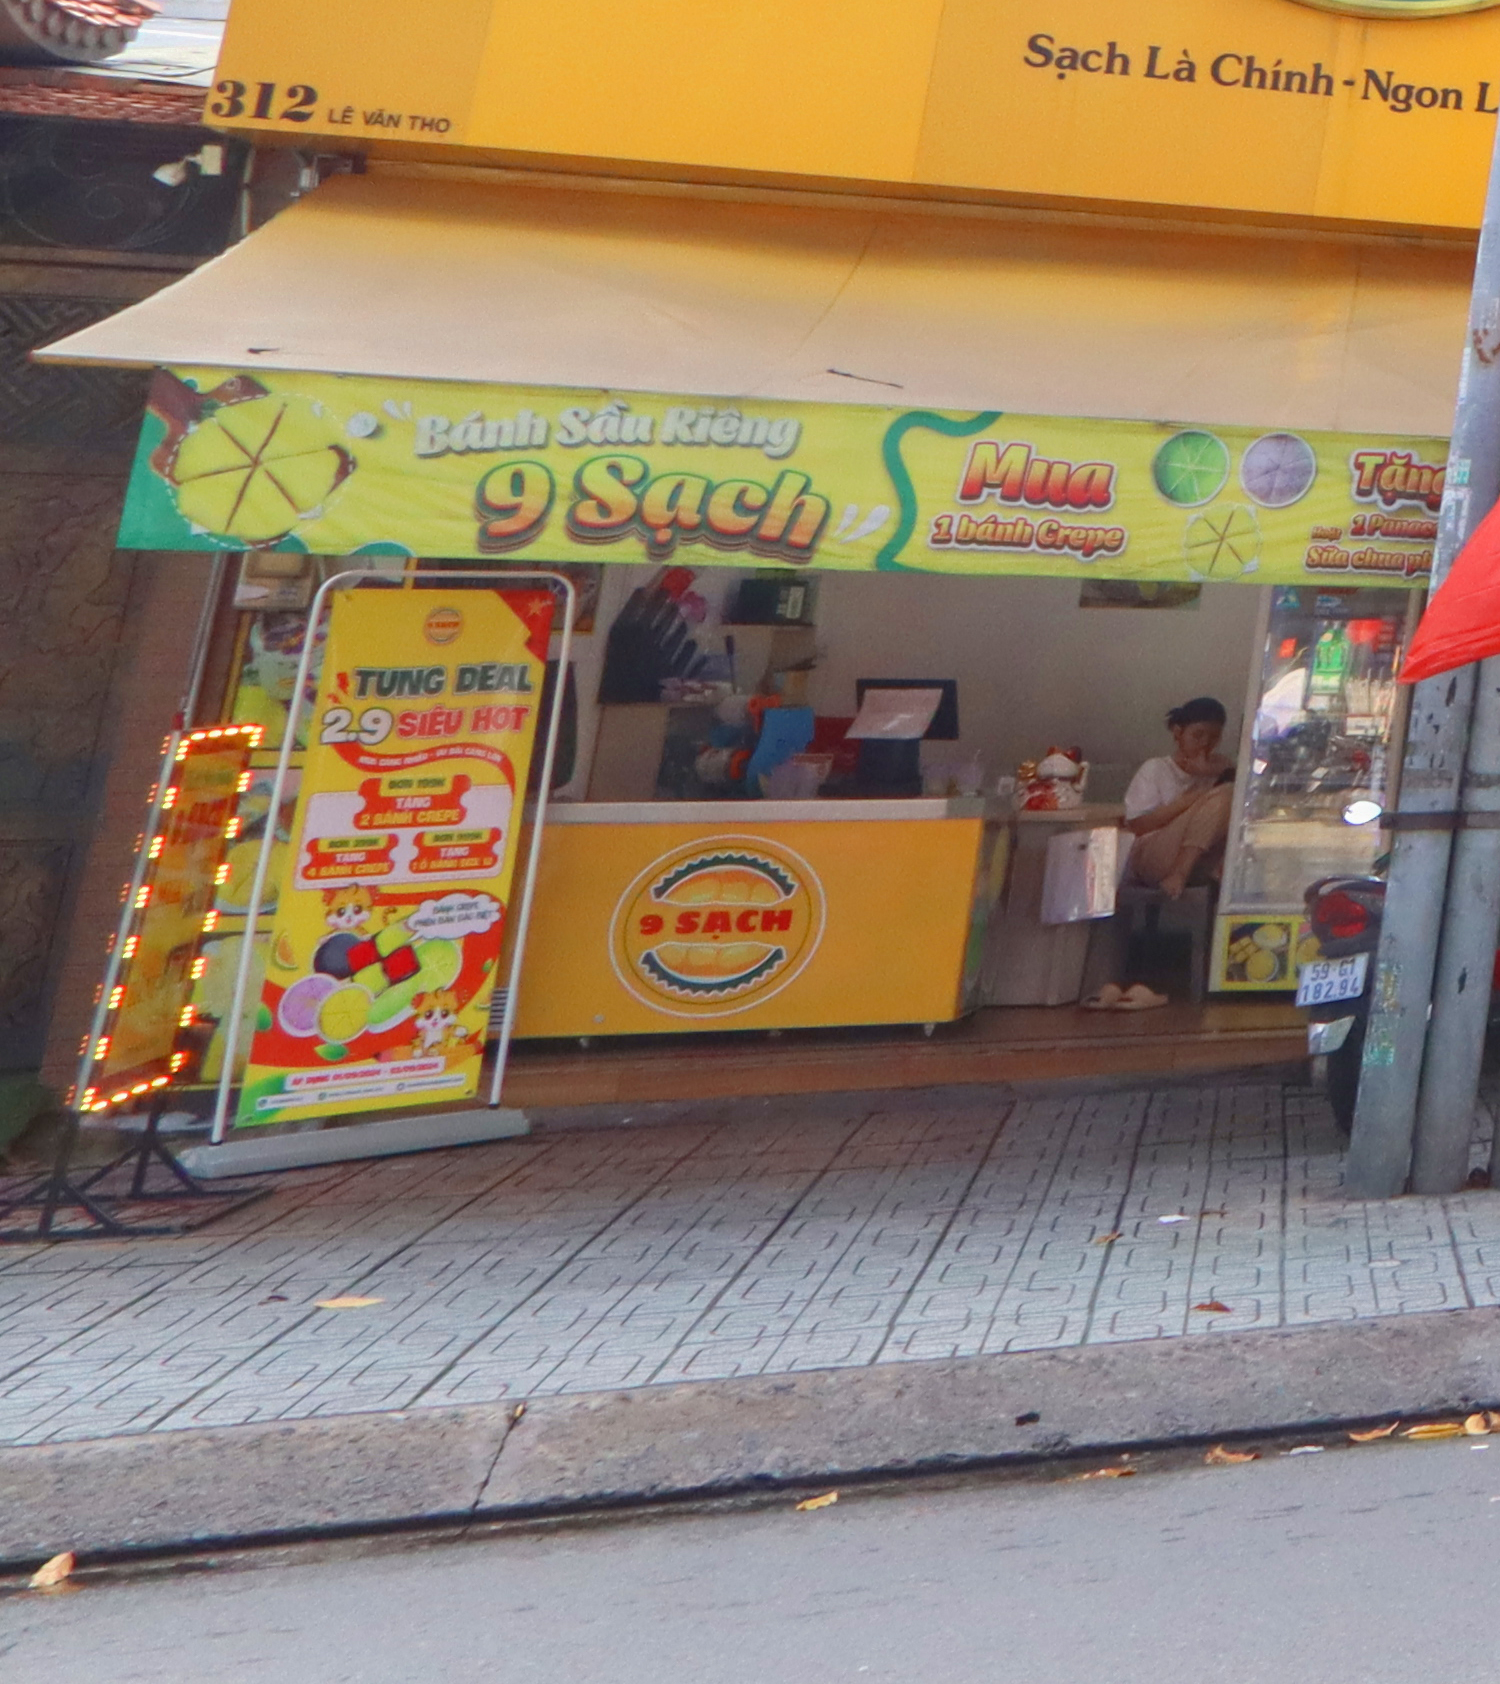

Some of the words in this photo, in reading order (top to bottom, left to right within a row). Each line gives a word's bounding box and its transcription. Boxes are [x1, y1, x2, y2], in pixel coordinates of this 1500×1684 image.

[1024, 33, 1131, 81] Sạch
[1144, 46, 1197, 86] Là
[1210, 52, 1335, 98] Chính
[1363, 68, 1463, 116] Ngon
[211, 79, 319, 123] 312
[328, 106, 354, 126] LÊ
[362, 109, 402, 129] VĂN
[410, 116, 450, 137] THỌ
[415, 405, 546, 459] Bánh
[556, 399, 649, 448] Sầu
[661, 406, 800, 459] Riêng
[957, 440, 1113, 510] Mua
[477, 459, 557, 554] 9
[567, 453, 830, 562] Sạch
[930, 515, 951, 549] 1
[955, 513, 1034, 550] bánh
[1037, 516, 1126, 556] Crepe
[1307, 545, 1349, 570] Sữa
[1352, 547, 1406, 571] chua
[354, 666, 446, 699] TUNG
[454, 662, 533, 695] DEAL
[321, 707, 393, 745] 2.9
[397, 705, 465, 740] SIÊU
[469, 705, 530, 734] HOT
[639, 914, 664, 935] 9
[675, 909, 793, 940] SẠCH
